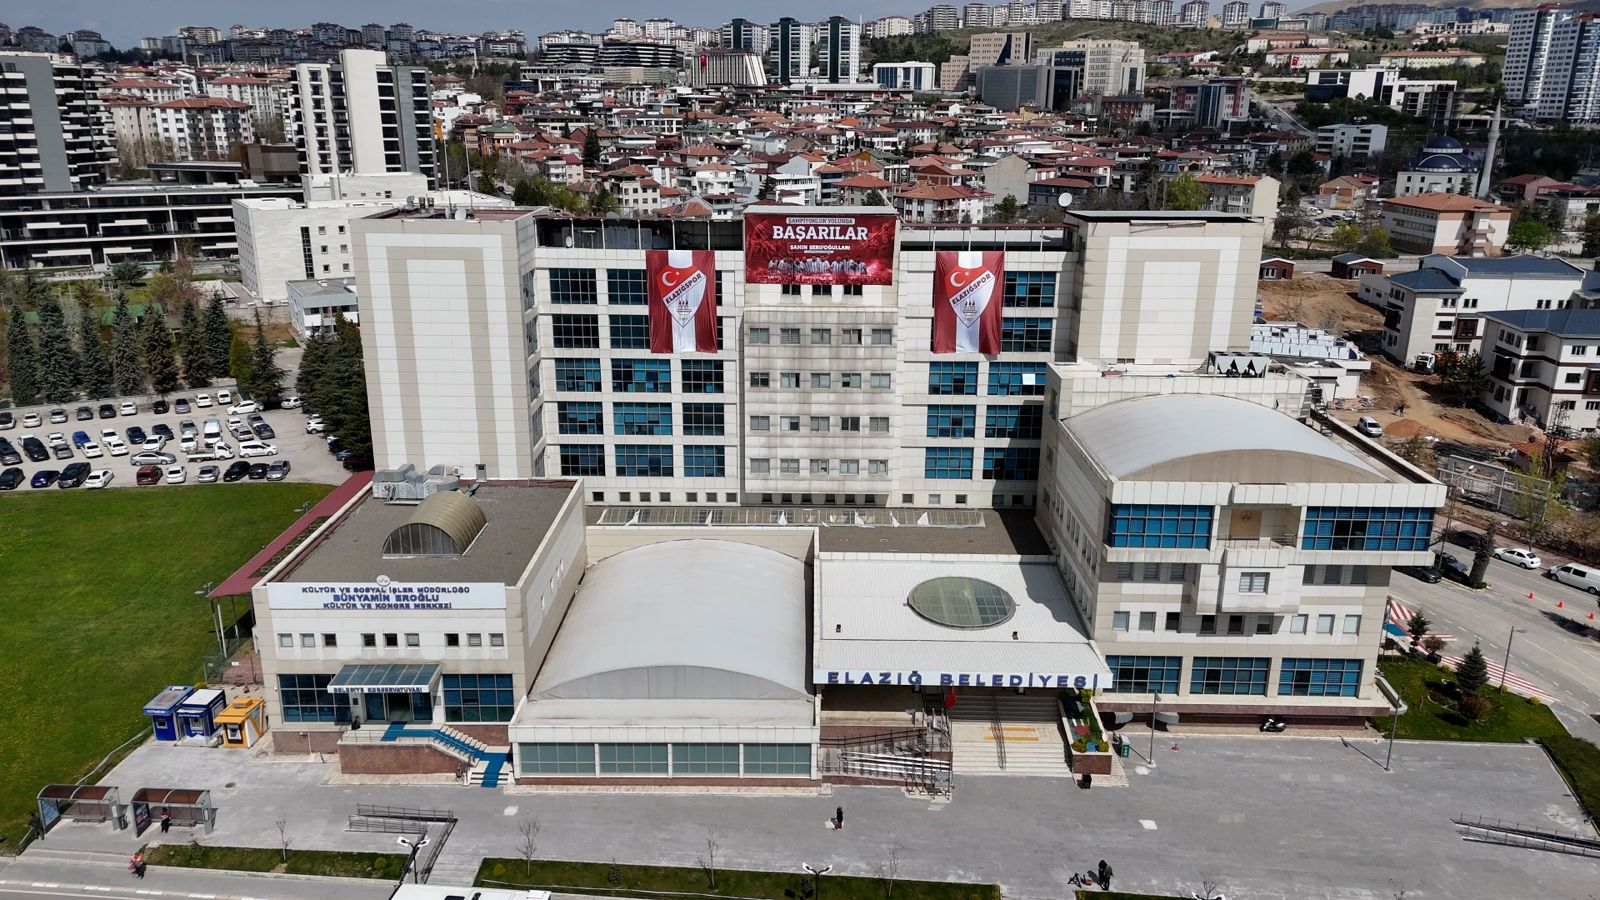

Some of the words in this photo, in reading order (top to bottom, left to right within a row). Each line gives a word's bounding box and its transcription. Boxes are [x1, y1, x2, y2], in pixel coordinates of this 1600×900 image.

[772, 225, 868, 242] BAŞARILAR
[665, 273, 702, 304] ELAZIĞSPOR
[952, 273, 992, 305] ELAZIĞSPOR
[333, 593, 390, 602] BÜNYAMİN
[395, 593, 440, 602] EROĞLU
[389, 586, 413, 594] İŞLER
[828, 671, 922, 685] ELAZIĞ
[940, 672, 1098, 689] BELEDİYESİ
